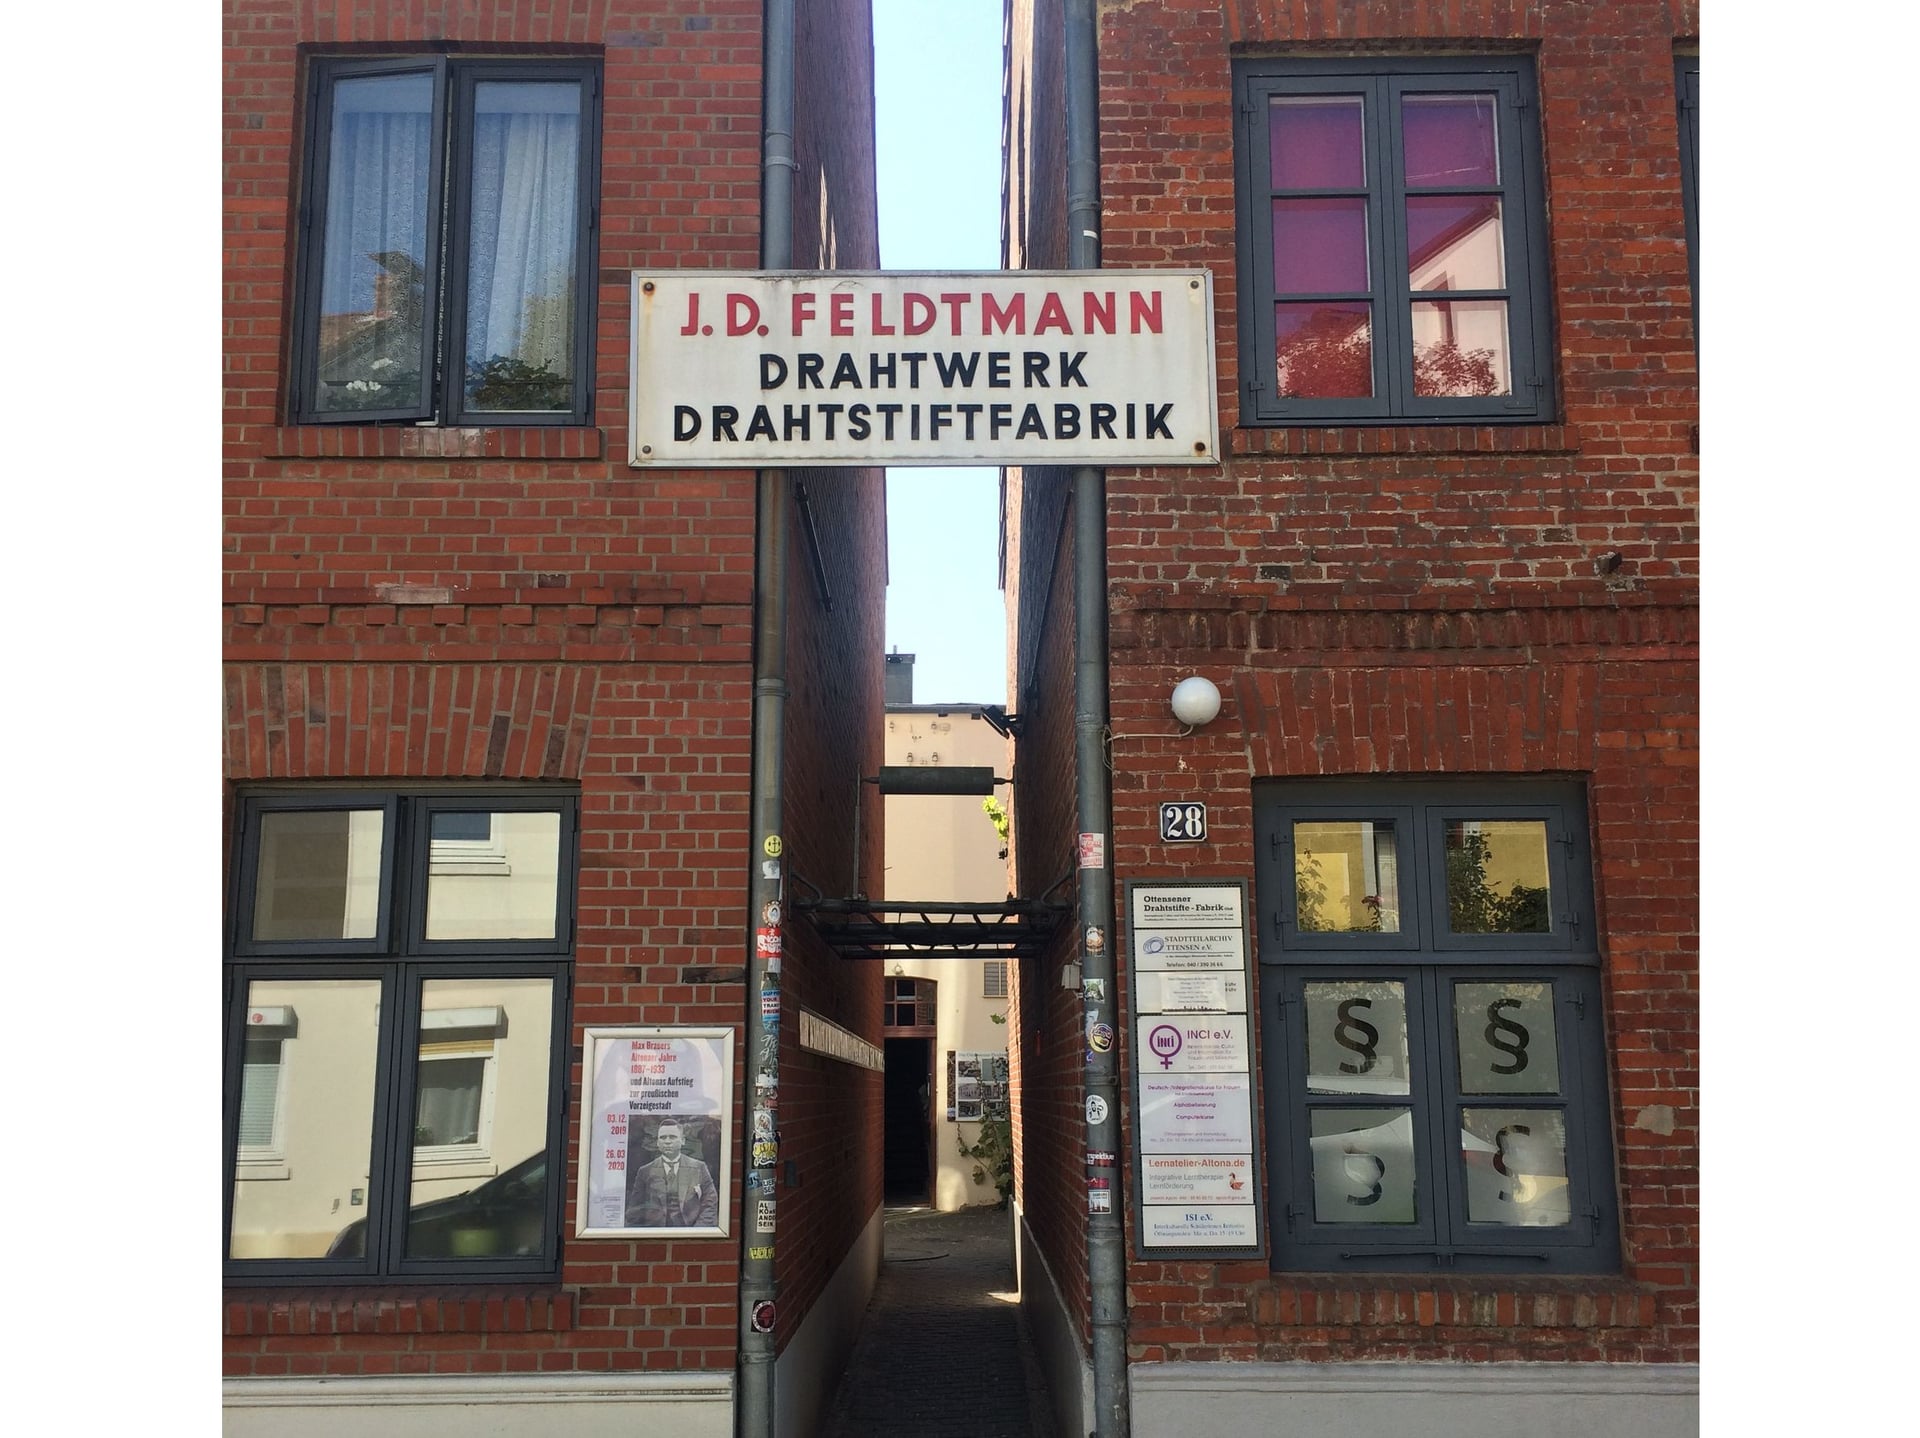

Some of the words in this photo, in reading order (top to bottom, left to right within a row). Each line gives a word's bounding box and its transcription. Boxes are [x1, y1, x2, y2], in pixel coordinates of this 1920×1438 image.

[791, 290, 1164, 337] FELDTMANN
[759, 351, 1089, 391] DRAHTWERK
[673, 402, 1175, 442] DRAHTSTIFTFABRIK
[1166, 806, 1203, 838] 28
[1143, 895, 1192, 903] Ottensener
[1143, 904, 1190, 912] Drahtstifte
[1187, 1029, 1210, 1040] INCI
[1213, 1029, 1234, 1040] e.V.
[631, 1041, 645, 1050] Max
[646, 1041, 671, 1050] Brauers
[658, 1053, 677, 1062] Jahre
[630, 1077, 642, 1086] und
[643, 1077, 666, 1086] Altonas
[667, 1077, 694, 1088] Aufstieg
[629, 1090, 640, 1098] zur
[641, 1089, 679, 1100] preußischen
[629, 1101, 672, 1111] Vorzeigestadt
[611, 1126, 627, 1135] 2019
[608, 1161, 625, 1170] 2020
[1149, 1159, 1246, 1167] Lernatelier-Altona.de
[1185, 1213, 1198, 1221] ISI
